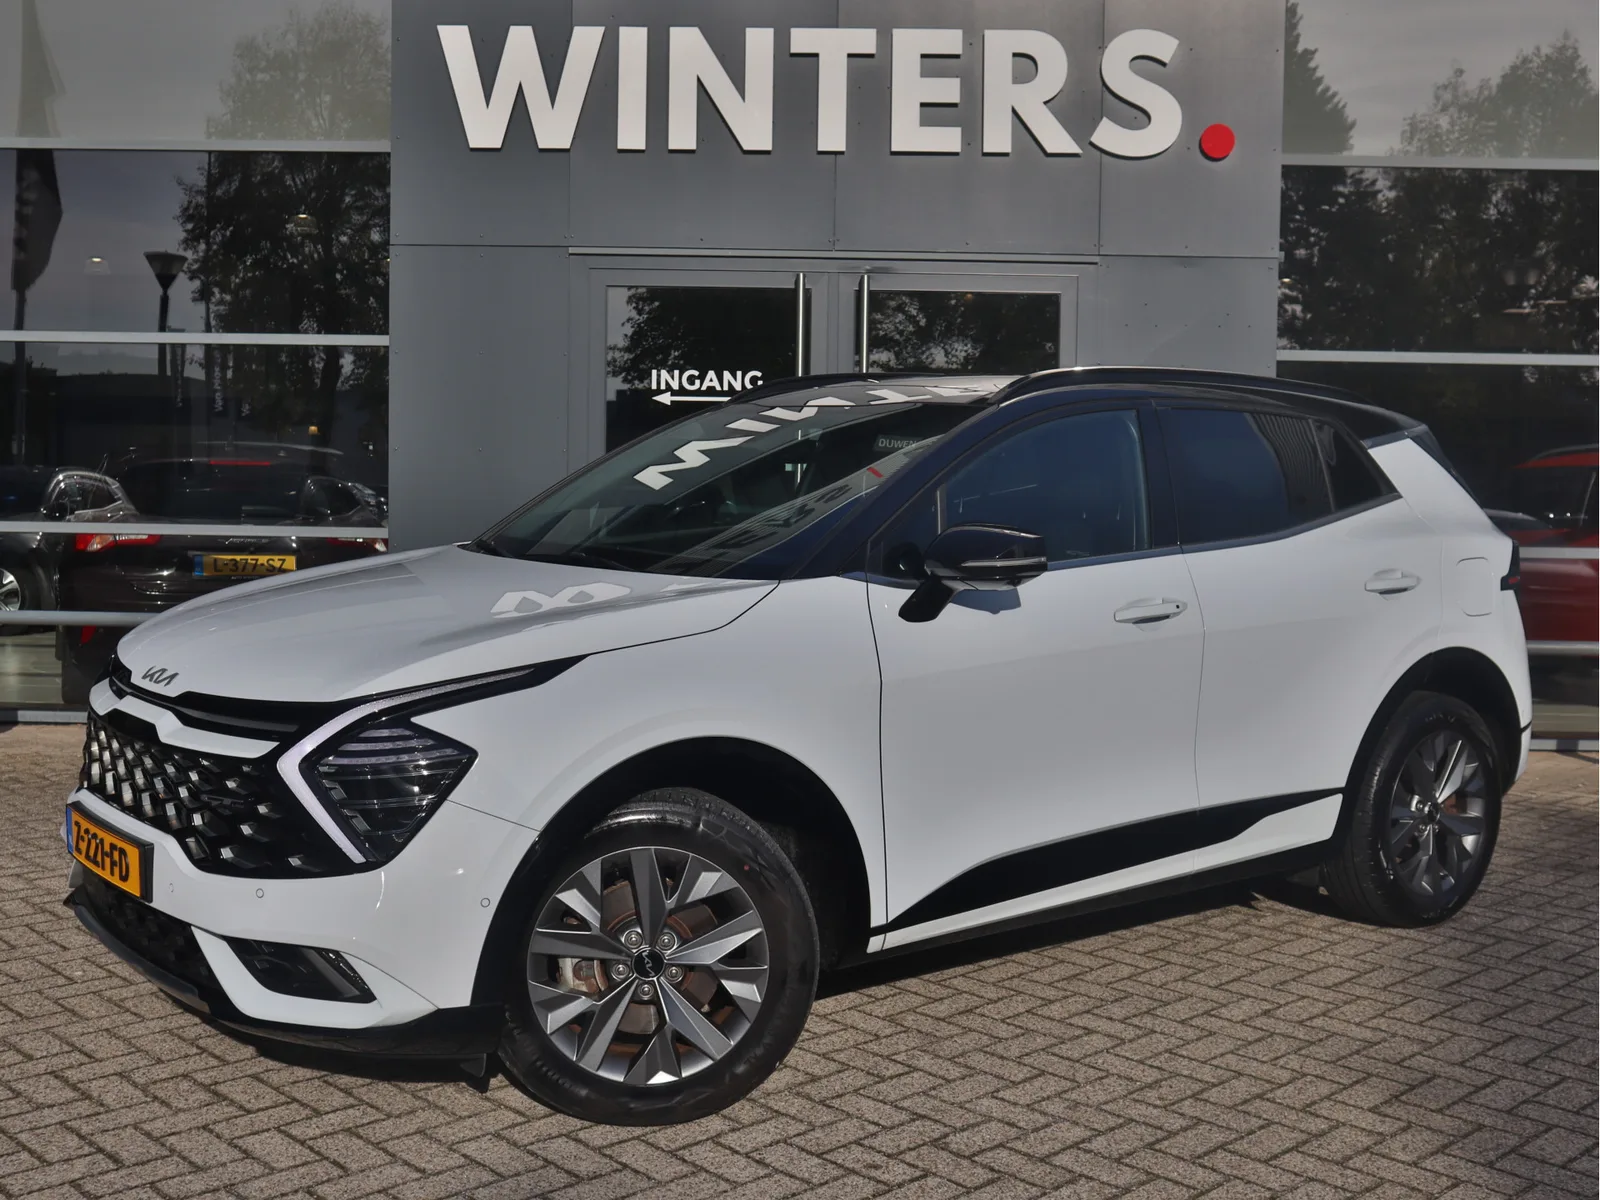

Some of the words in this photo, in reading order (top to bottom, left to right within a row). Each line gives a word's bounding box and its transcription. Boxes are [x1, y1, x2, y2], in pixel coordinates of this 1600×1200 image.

[651, 369, 763, 391] INGANG
[213, 558, 287, 573] L-377-SZ
[74, 820, 130, 883] Z-221-FD
